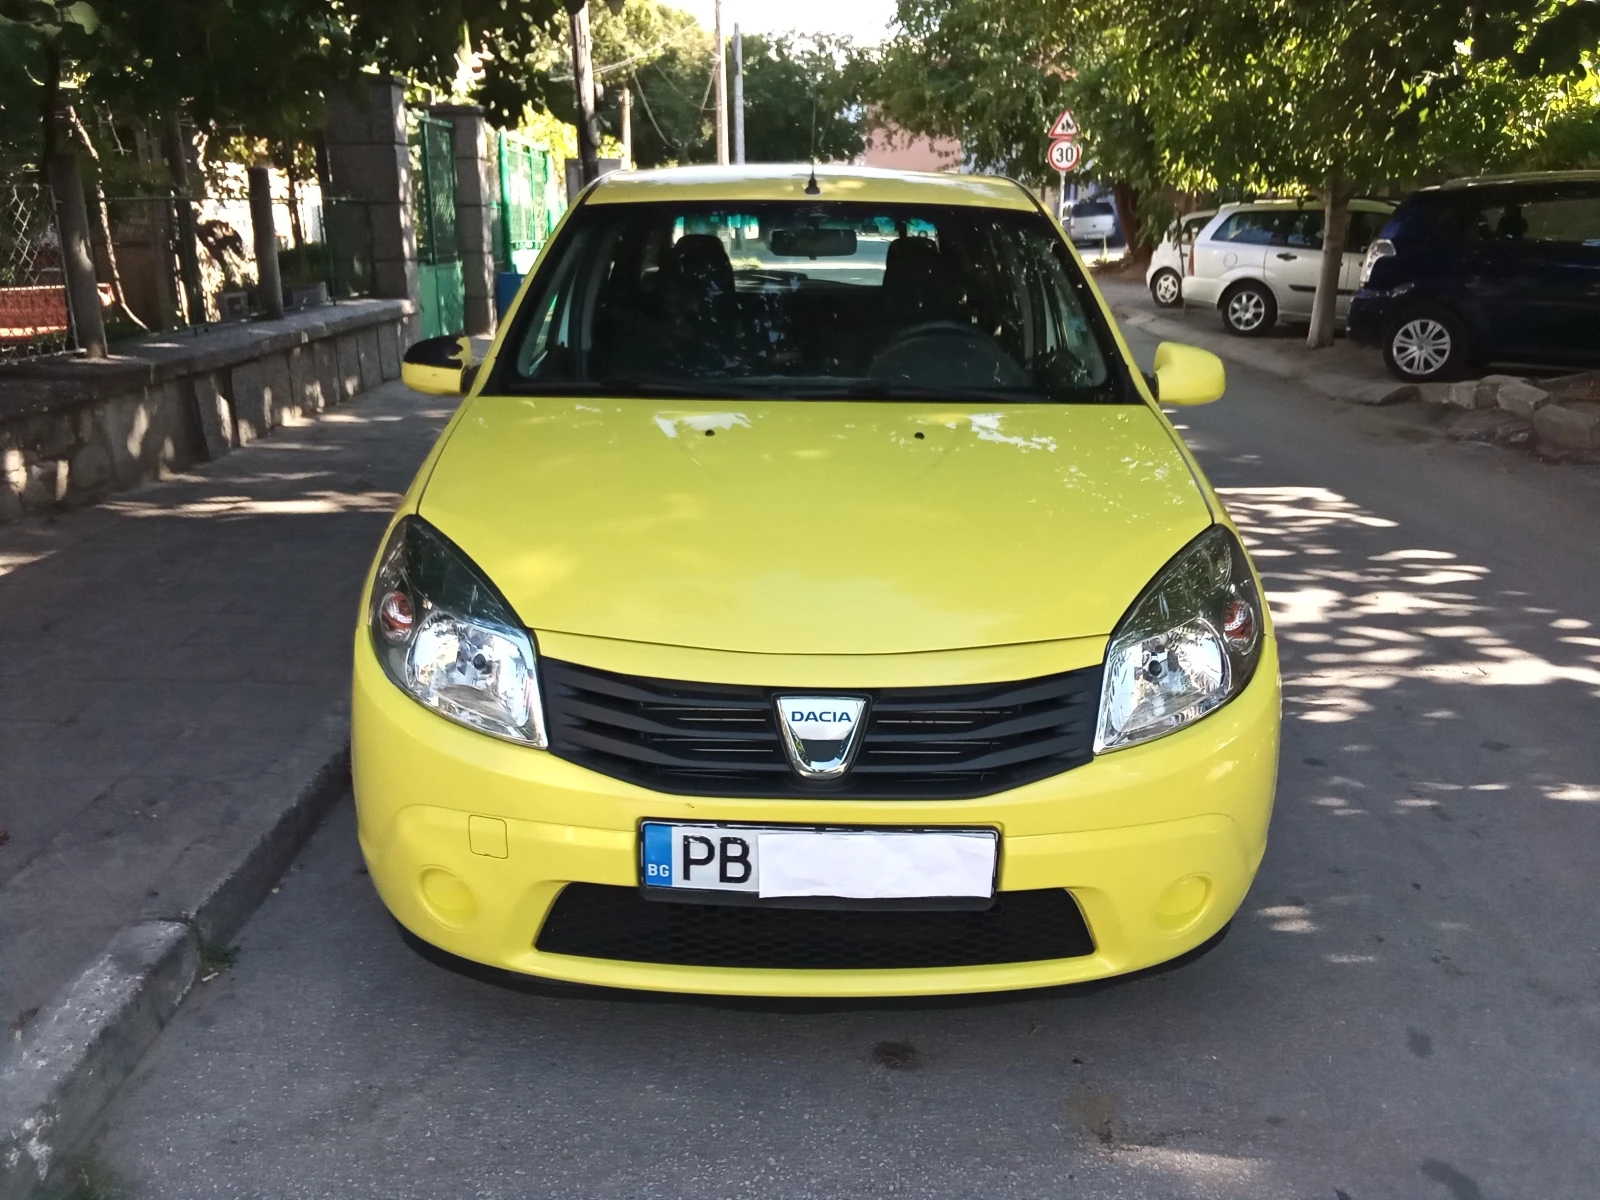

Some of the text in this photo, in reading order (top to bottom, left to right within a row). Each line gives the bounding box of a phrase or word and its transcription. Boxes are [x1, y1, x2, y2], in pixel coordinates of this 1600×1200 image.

[1056, 147, 1073, 163] 30
[791, 710, 852, 723] DACIA
[683, 835, 753, 884] PB
[647, 863, 670, 878] BG
